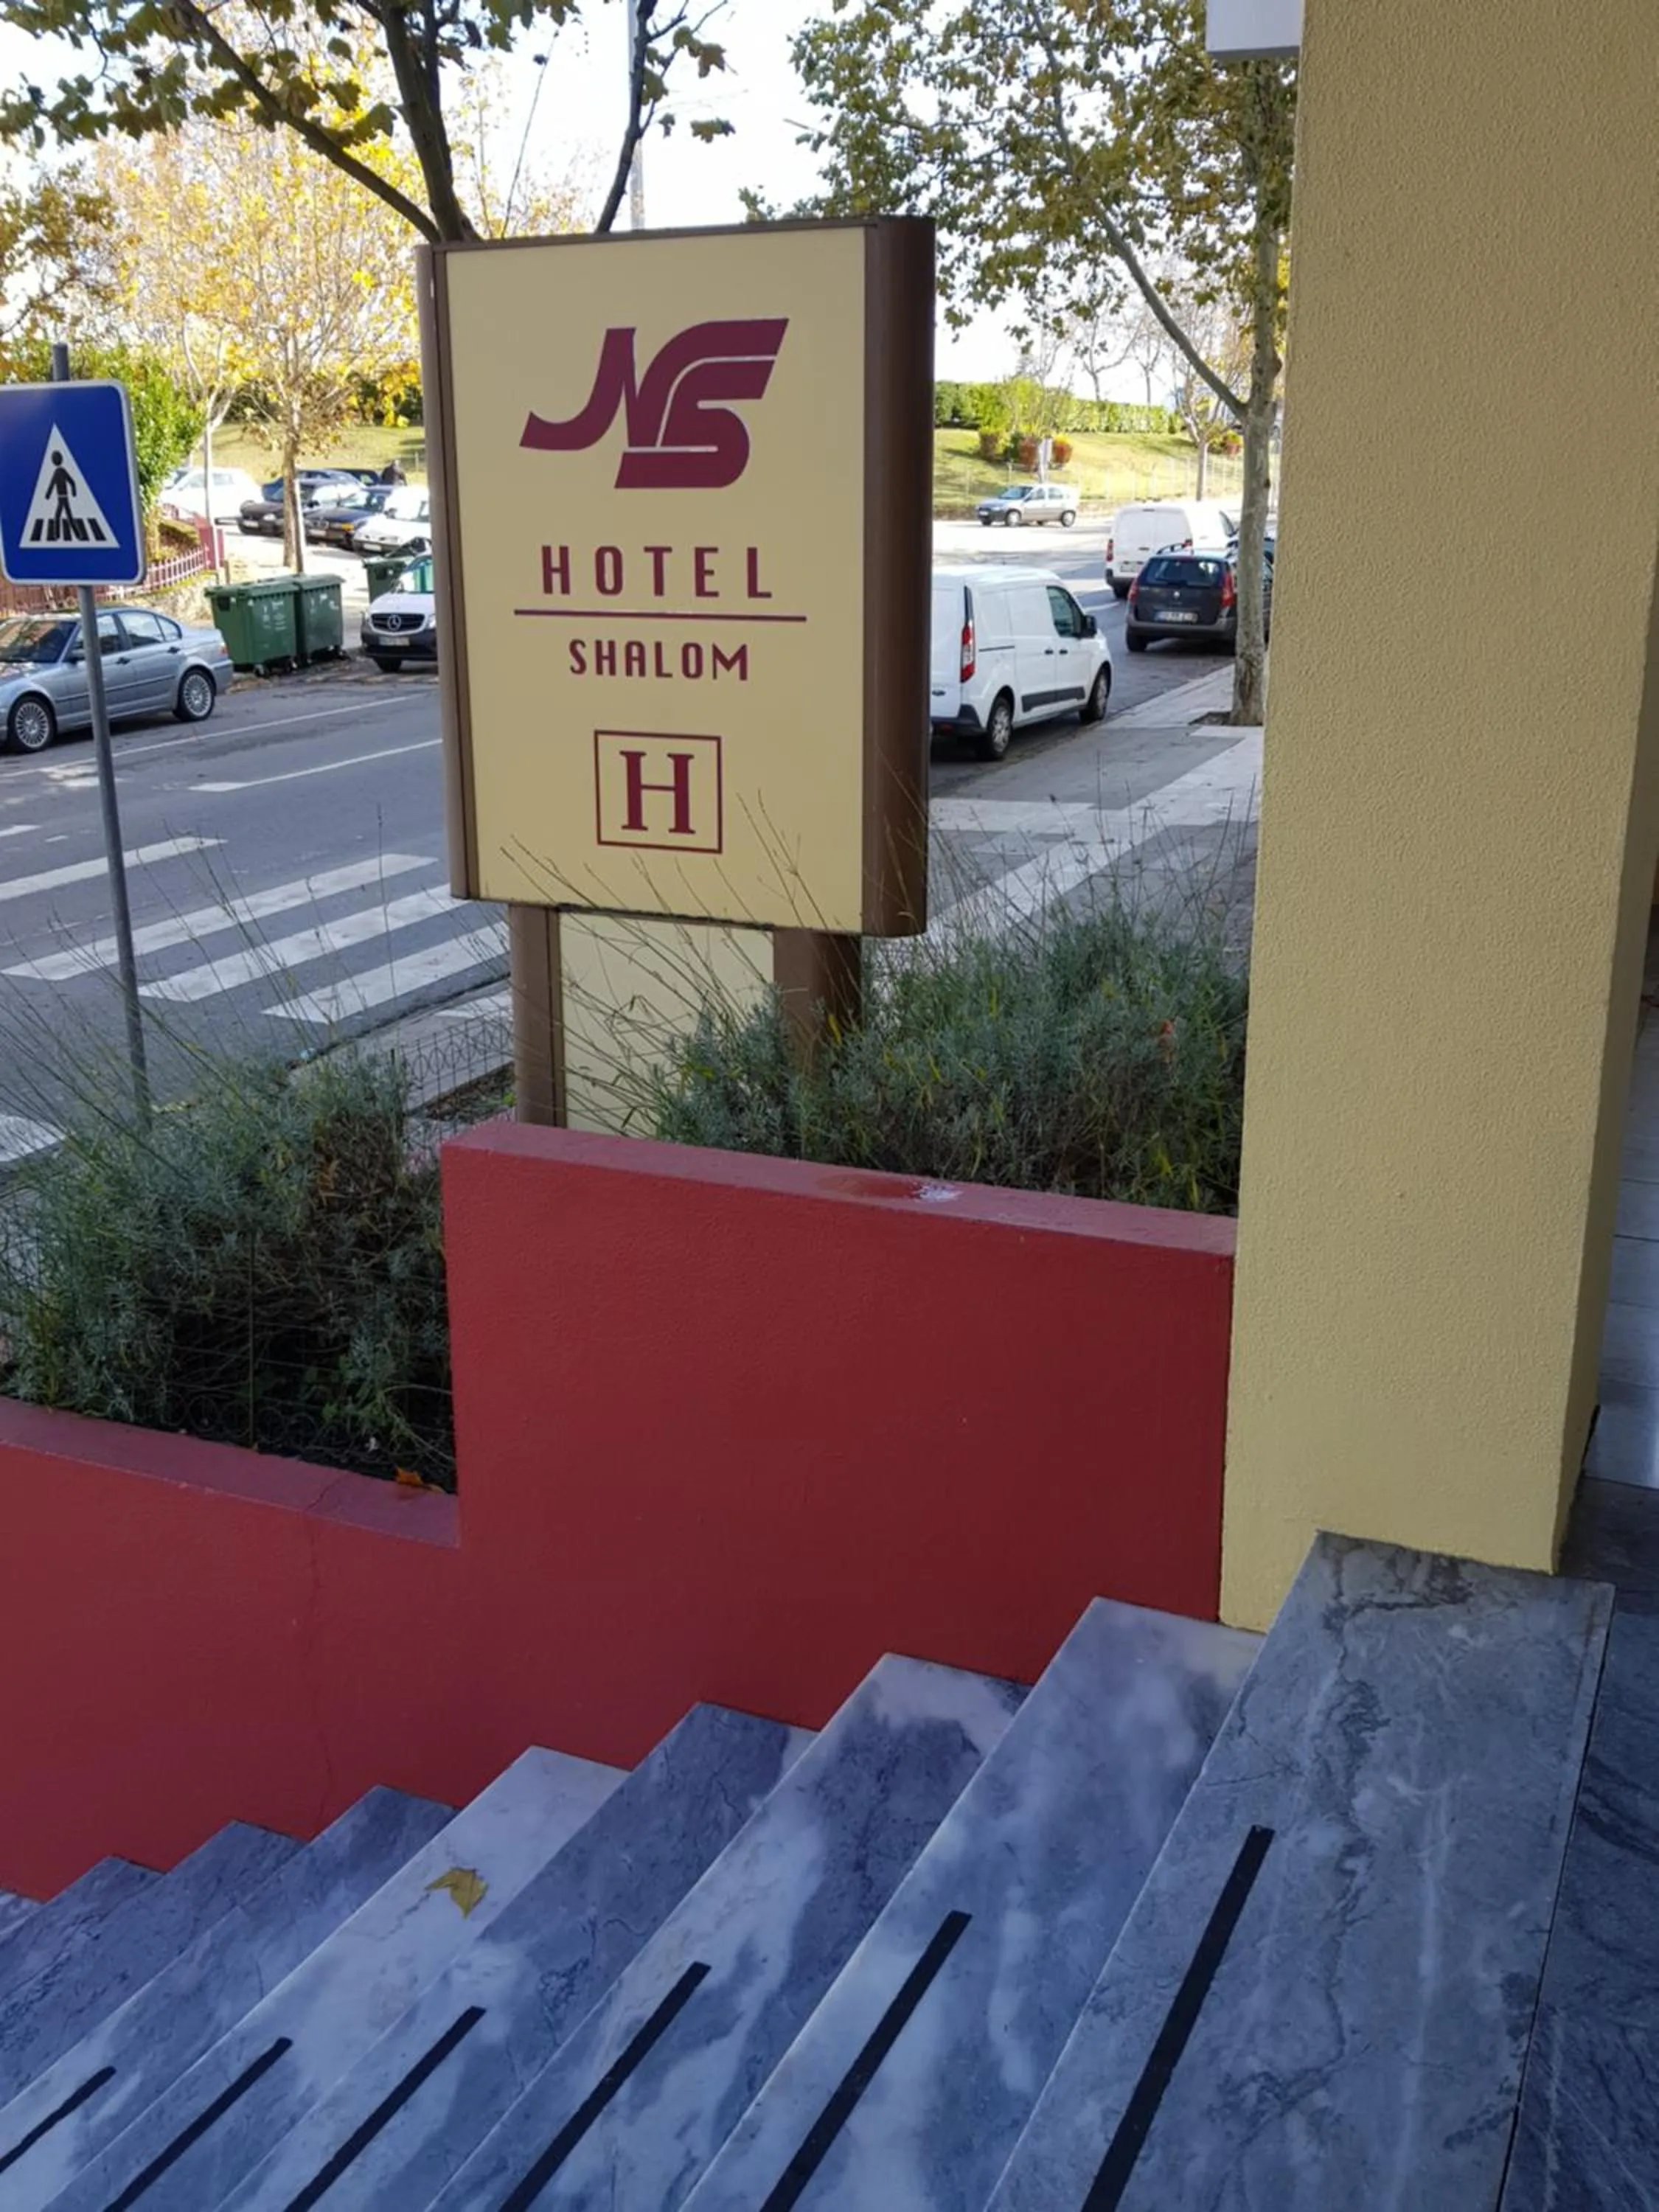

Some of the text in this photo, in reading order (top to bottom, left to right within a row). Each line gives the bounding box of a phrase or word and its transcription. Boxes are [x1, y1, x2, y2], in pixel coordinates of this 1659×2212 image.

[541, 545, 772, 599] HOTEL
[568, 639, 748, 681] SHALOM
[619, 750, 696, 835] H
